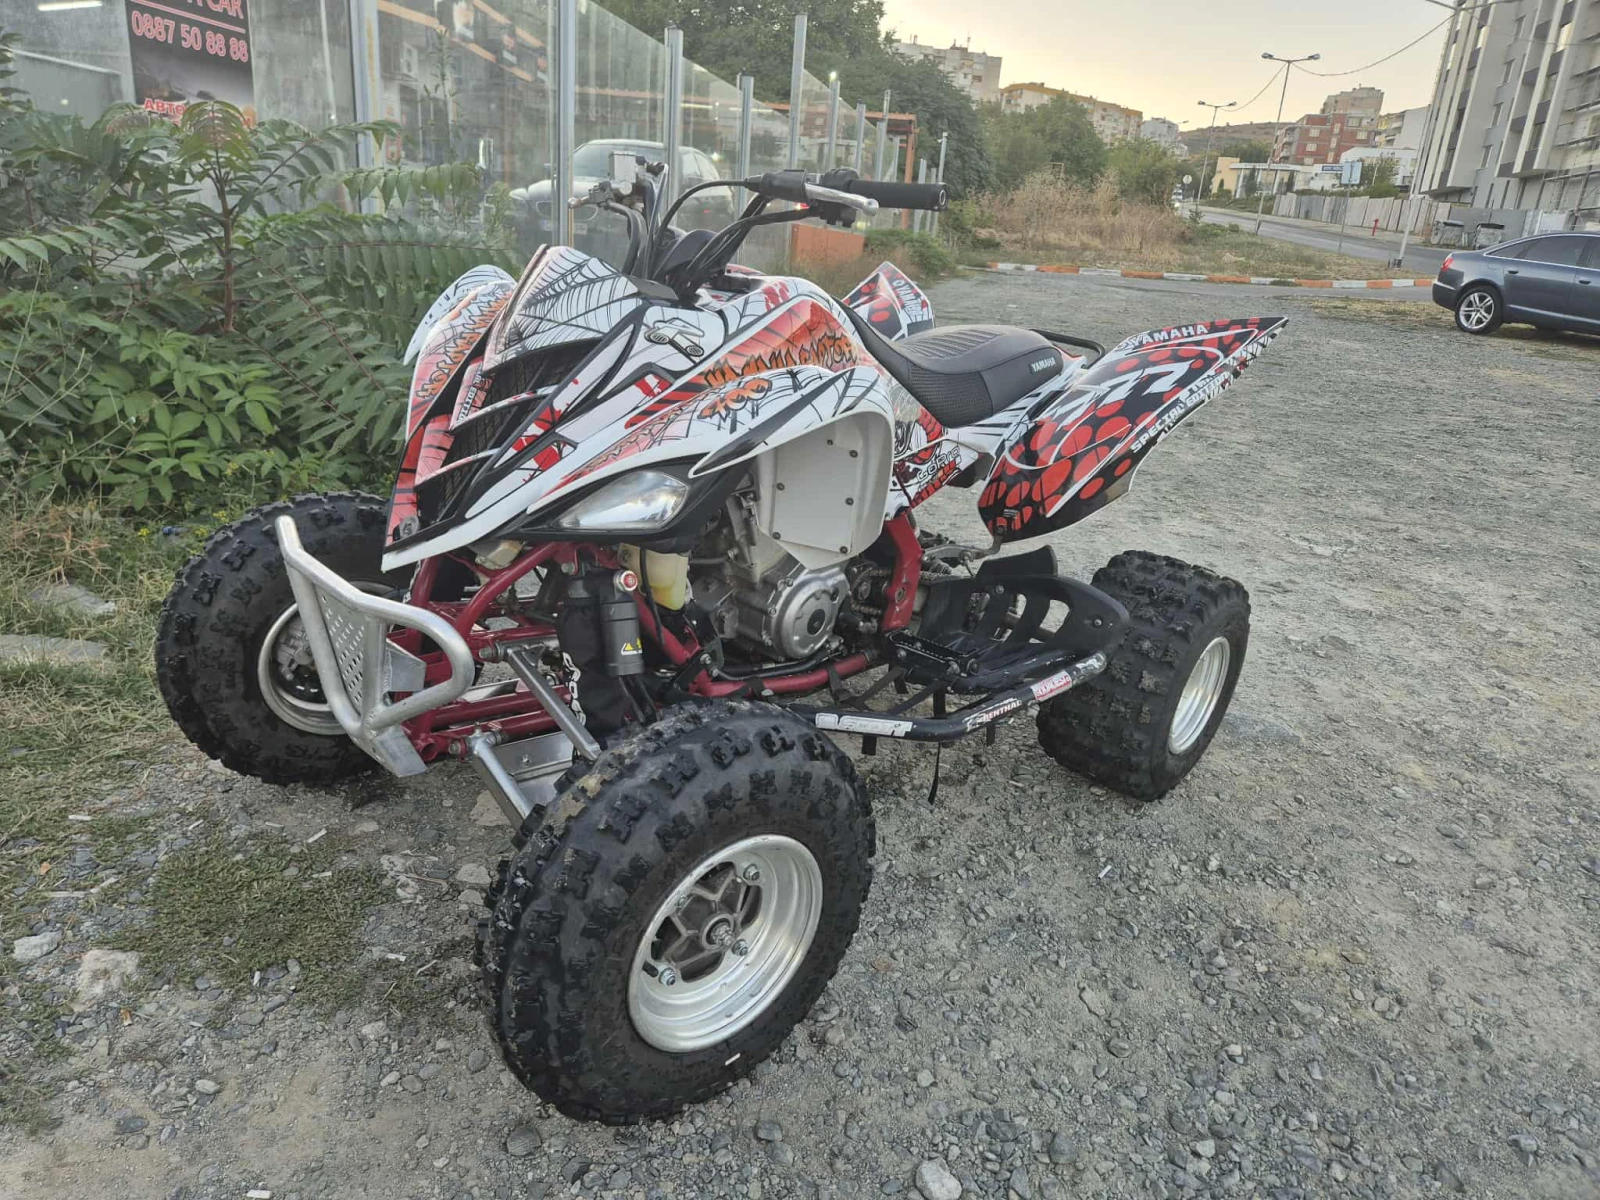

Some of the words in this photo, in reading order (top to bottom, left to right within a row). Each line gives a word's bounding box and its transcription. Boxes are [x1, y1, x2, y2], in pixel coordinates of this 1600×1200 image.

[132, 11, 175, 43] 0887
[181, 24, 201, 50] 50
[206, 31, 226, 56] 88
[230, 37, 248, 62] 88
[1129, 324, 1208, 347] YAMAHA
[1030, 356, 1056, 372] YAMAHA
[1131, 404, 1184, 454] SPECIAL
